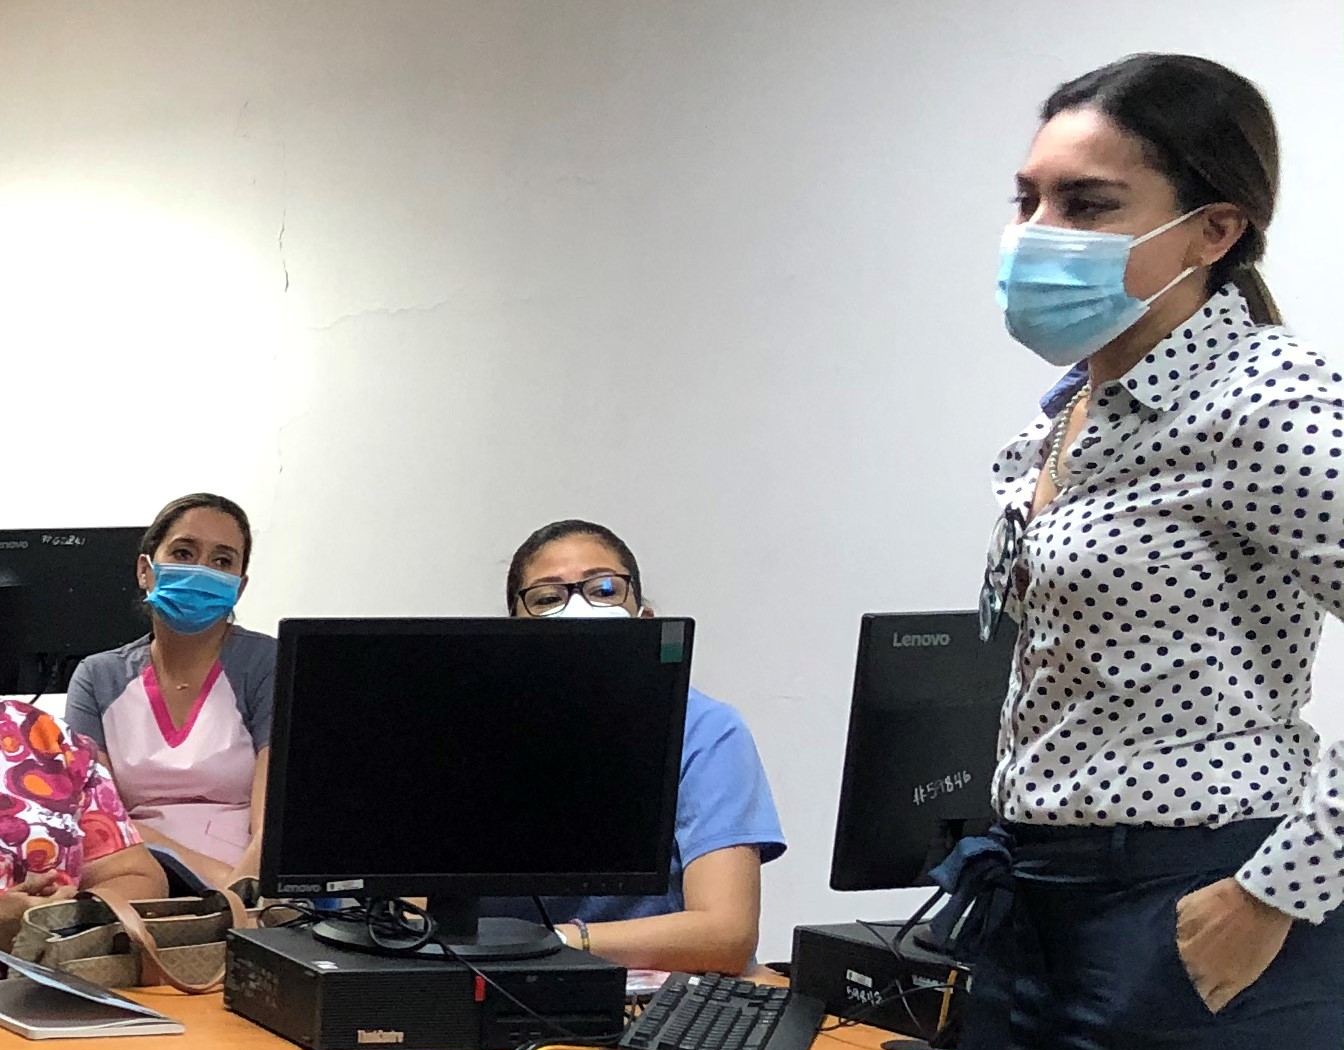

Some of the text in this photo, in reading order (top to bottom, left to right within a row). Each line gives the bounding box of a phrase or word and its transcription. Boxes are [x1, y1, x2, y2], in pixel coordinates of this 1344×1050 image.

[892, 632, 952, 648] Lenovo
[912, 769, 972, 806] #59846
[277, 882, 322, 893] Lenovo
